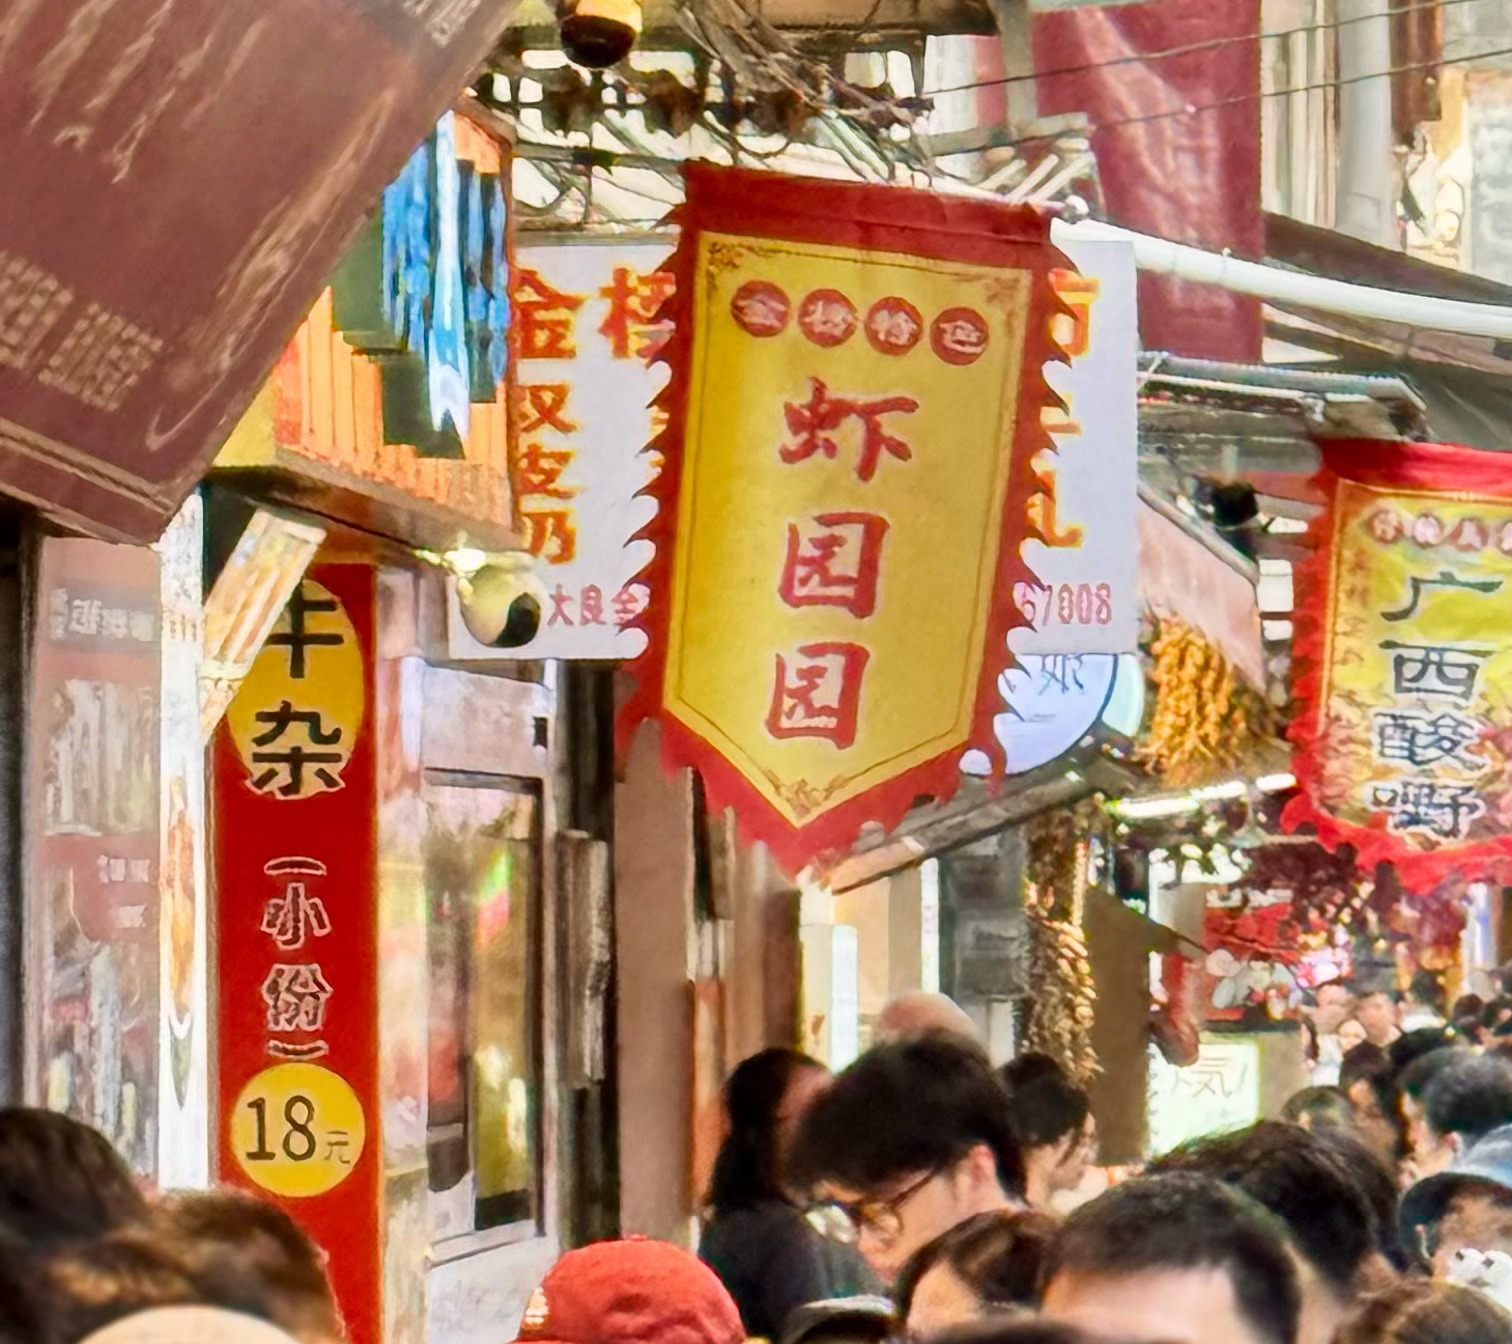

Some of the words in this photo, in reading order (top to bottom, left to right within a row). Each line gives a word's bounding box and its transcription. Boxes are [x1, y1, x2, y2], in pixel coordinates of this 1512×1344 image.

[766, 375, 921, 751] 虾园园
[252, 576, 345, 797] 牛杂
[244, 1093, 352, 1165] 18元
